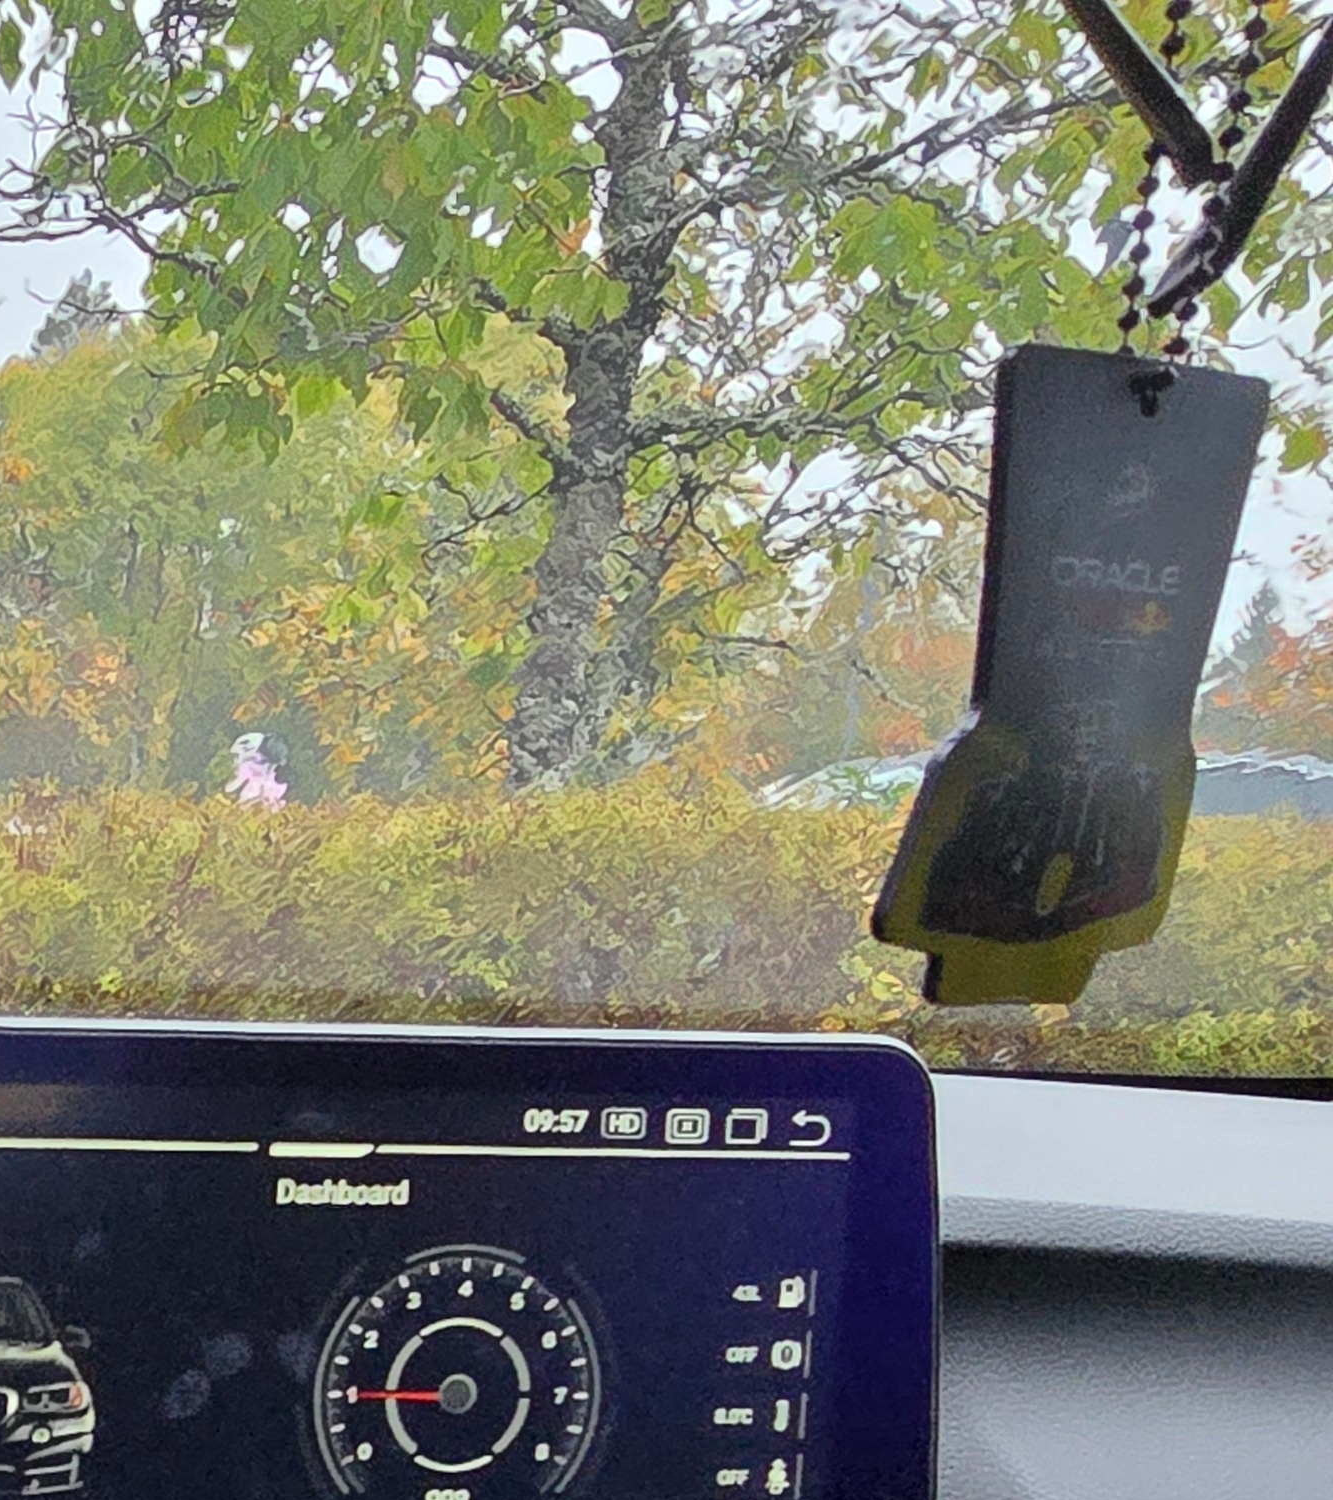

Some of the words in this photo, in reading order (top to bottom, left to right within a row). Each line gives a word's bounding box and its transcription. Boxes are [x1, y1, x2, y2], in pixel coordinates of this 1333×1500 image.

[1051, 555, 1182, 595] ORACLE
[524, 1109, 589, 1132] 09:57
[609, 1114, 640, 1133] HD
[276, 1178, 409, 1205] Dashboard
[458, 1280, 473, 1297] 4
[406, 1292, 421, 1309] 3
[363, 1330, 378, 1349] 2
[346, 1386, 358, 1403] 1
[554, 1387, 568, 1404] 7
